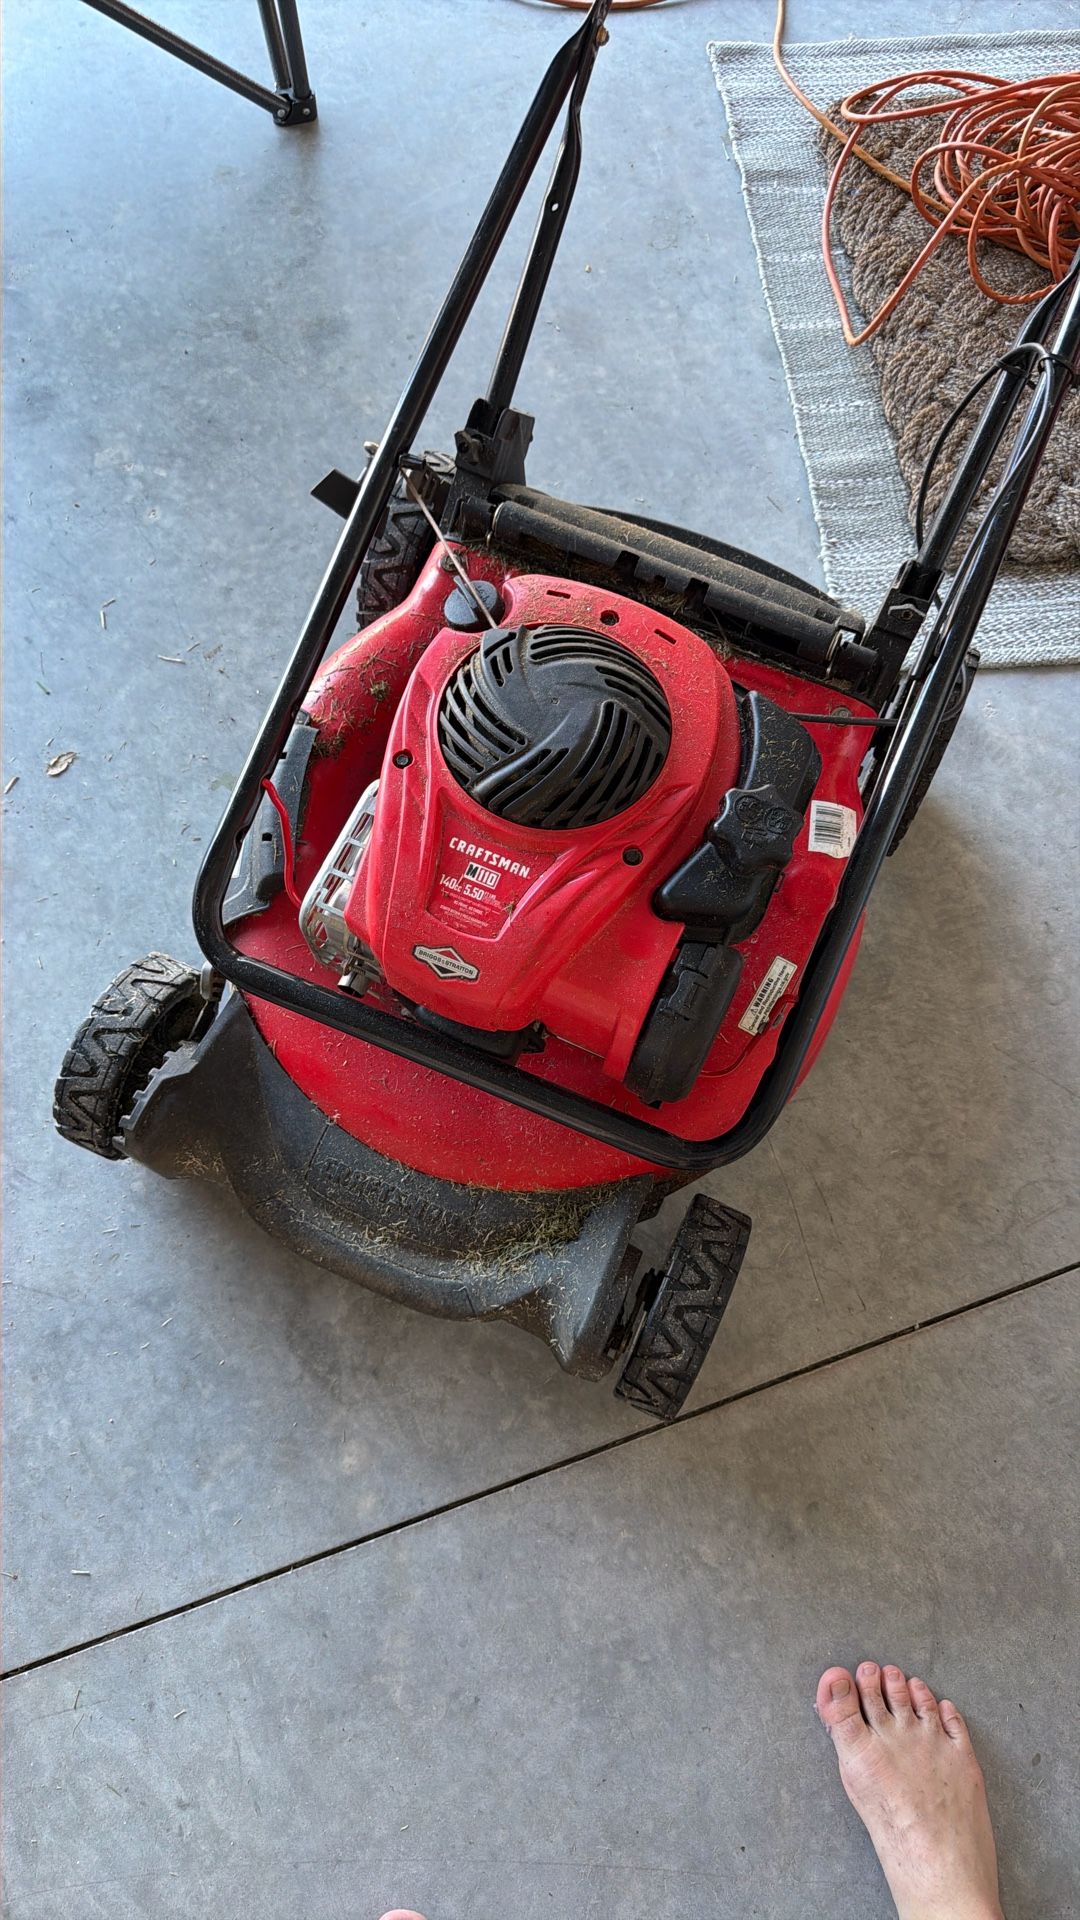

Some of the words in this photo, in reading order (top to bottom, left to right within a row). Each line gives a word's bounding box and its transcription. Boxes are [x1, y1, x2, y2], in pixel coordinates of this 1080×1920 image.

[449, 837, 531, 879] CRAFTSMAN
[440, 874, 463, 893] 140cc
[463, 883, 485, 901] 5.50
[465, 862, 500, 888] M110
[753, 977, 774, 1008] WARNING
